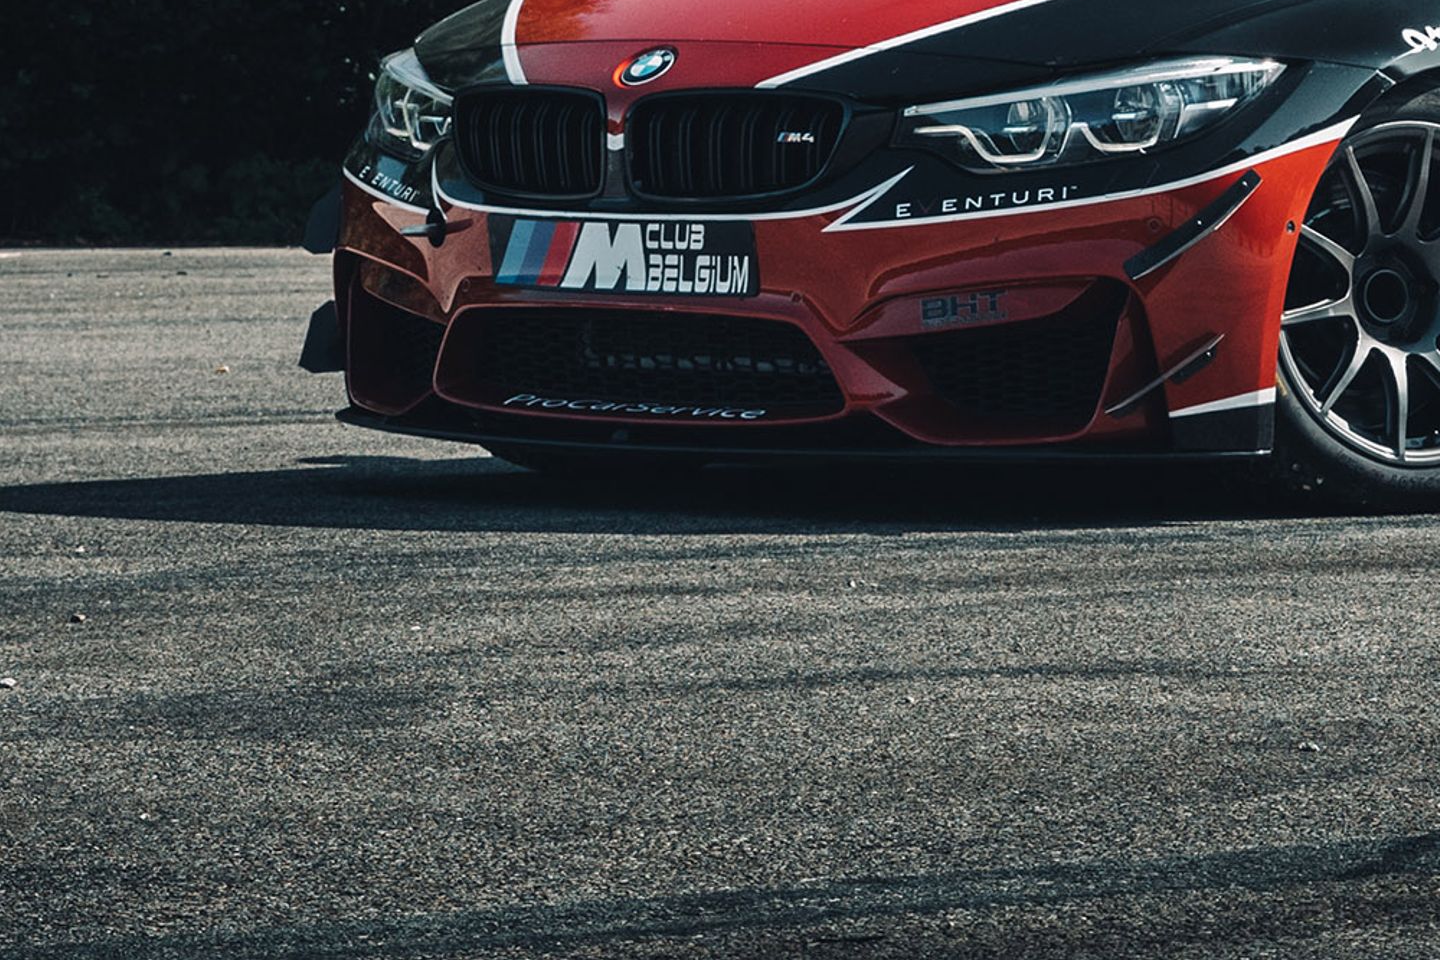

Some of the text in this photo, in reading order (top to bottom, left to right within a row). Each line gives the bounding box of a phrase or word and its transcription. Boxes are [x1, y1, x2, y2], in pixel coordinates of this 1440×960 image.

[784, 131, 815, 144] M4
[646, 223, 705, 250] CLUB
[922, 292, 1007, 321] BHT
